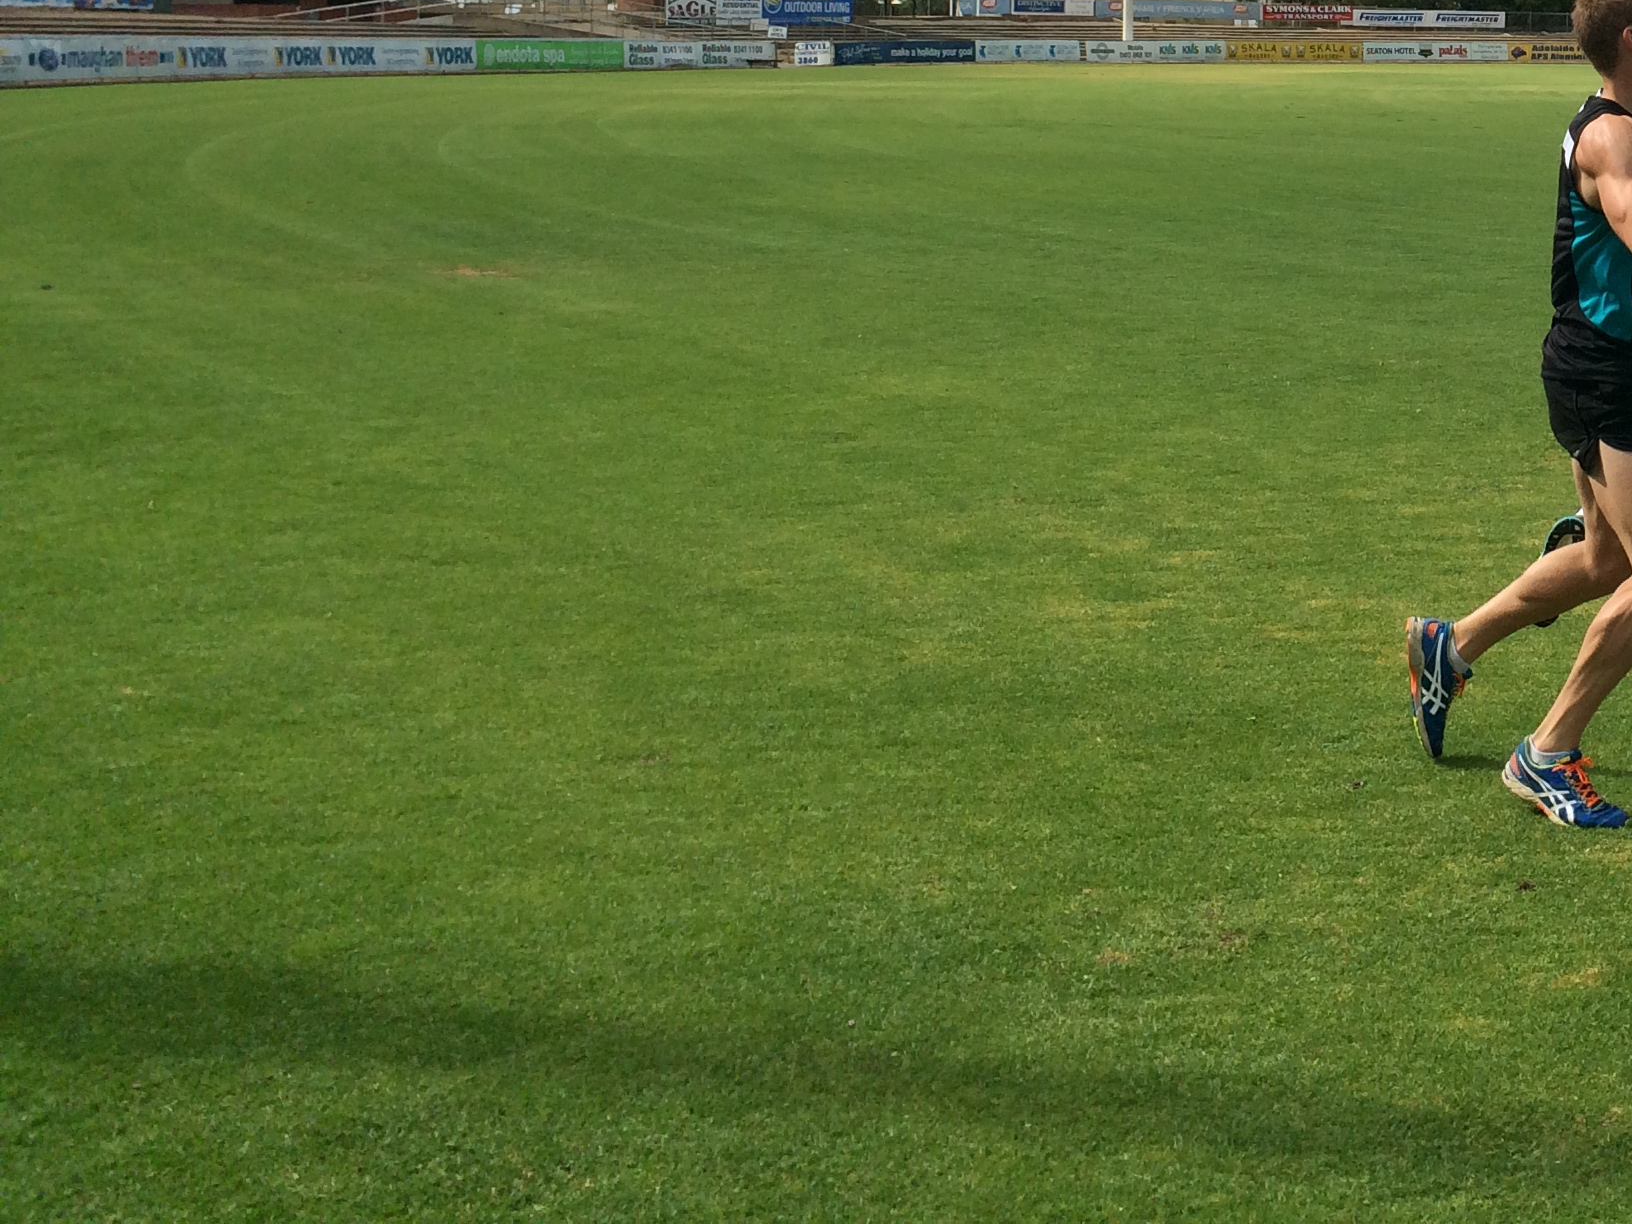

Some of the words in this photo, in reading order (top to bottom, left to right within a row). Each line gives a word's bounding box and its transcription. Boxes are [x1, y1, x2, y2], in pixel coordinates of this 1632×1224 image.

[784, 2, 822, 13] OUTDOOR
[824, 2, 850, 13] LIVING
[1359, 13, 1424, 22] FREIGHTMASTER
[1436, 14, 1500, 23] FREIGHTMASTER
[629, 45, 658, 53] Reliable
[703, 45, 732, 53] Reliable
[796, 42, 830, 50] CIVIL
[1241, 43, 1277, 53] SKALA
[1309, 43, 1346, 53] SKALA
[189, 46, 228, 68] YORK
[286, 46, 322, 66] YORK
[338, 46, 376, 66] YORK
[436, 46, 475, 65] YORK
[497, 46, 540, 64] endota
[543, 49, 565, 67] spa
[891, 49, 908, 57] make
[917, 48, 941, 58] holiday
[942, 50, 957, 58] your
[958, 48, 973, 57] goal
[629, 54, 655, 66] Glass
[703, 53, 729, 64] Glass
